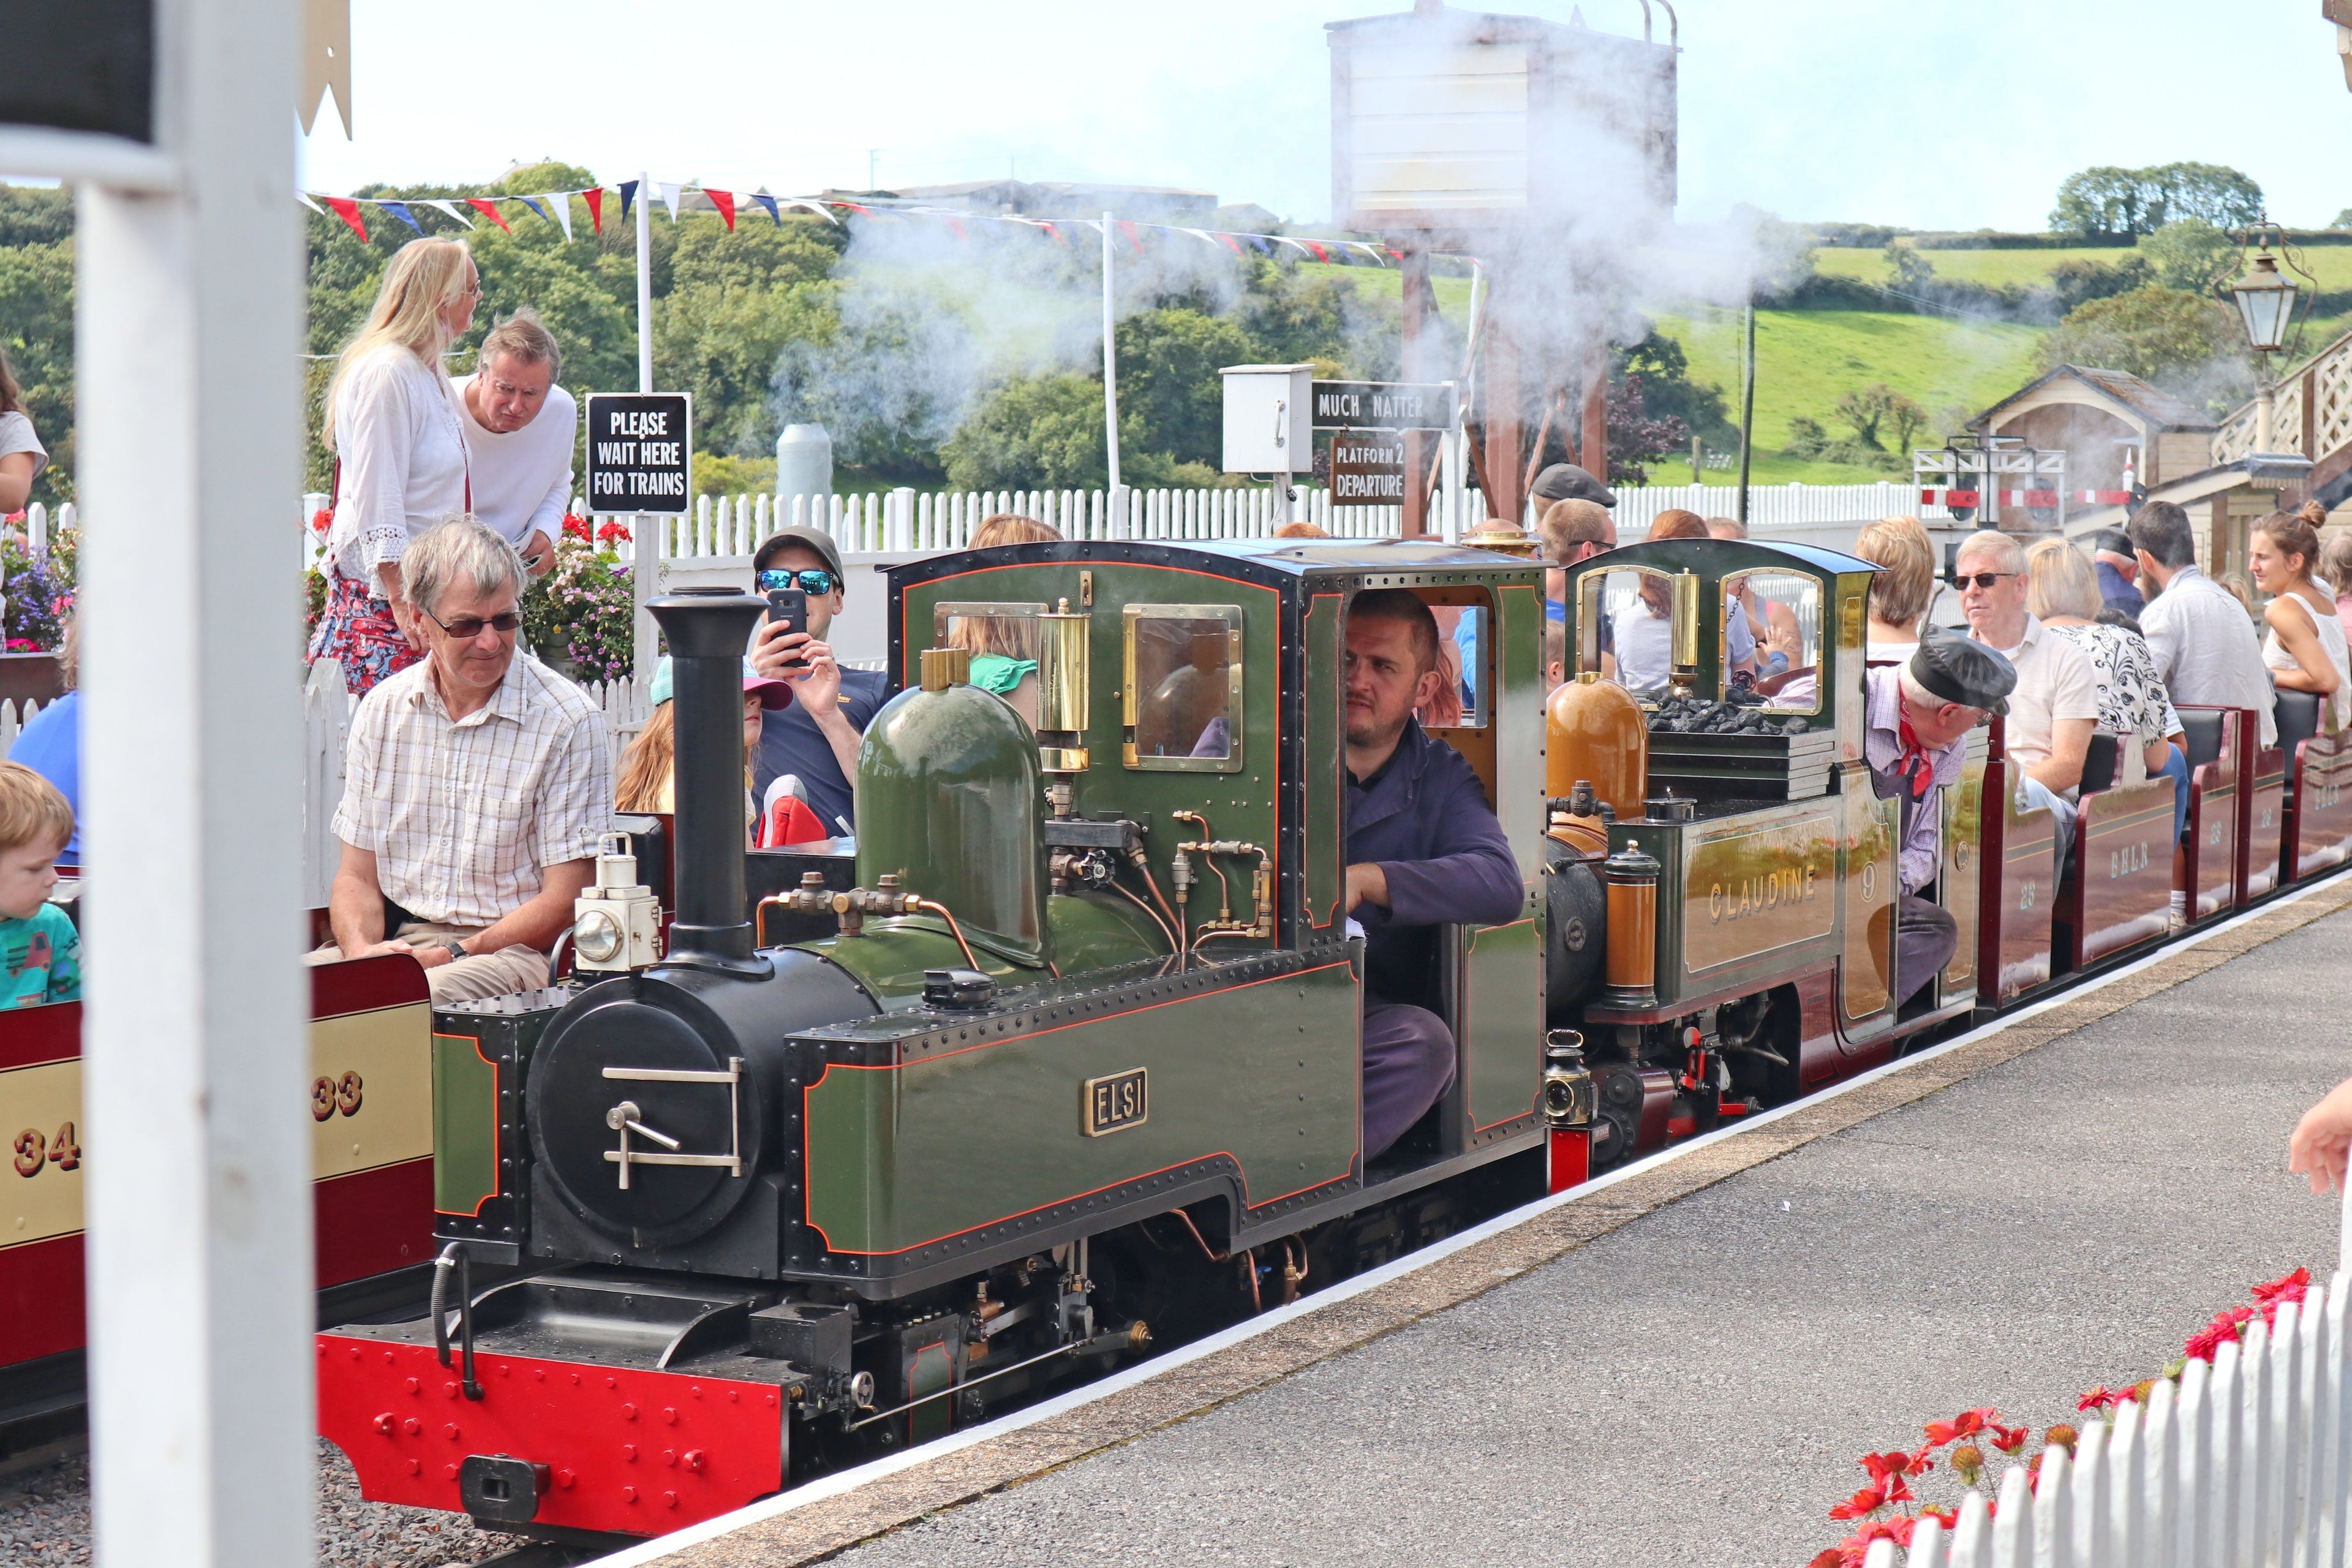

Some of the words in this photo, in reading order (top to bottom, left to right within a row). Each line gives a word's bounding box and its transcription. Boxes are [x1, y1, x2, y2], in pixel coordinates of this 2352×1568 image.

[1319, 394, 1359, 417] MUCH
[1373, 396, 1422, 417] NATTER
[611, 412, 667, 435] PLEASE
[598, 442, 636, 465] WAIT
[641, 442, 680, 465] HERE
[1337, 447, 1393, 464] PLATFORM
[1396, 443, 1403, 464] 2
[594, 472, 624, 495] FOR
[628, 472, 684, 496] TRAINS
[1337, 474, 1403, 497] DEPARTURE
[1863, 865, 1875, 898] 9
[1710, 864, 1815, 924] CLAUDINE
[311, 1070, 363, 1122] 33
[1097, 1079, 1141, 1125] ELSI
[14, 1121, 81, 1178] 34
